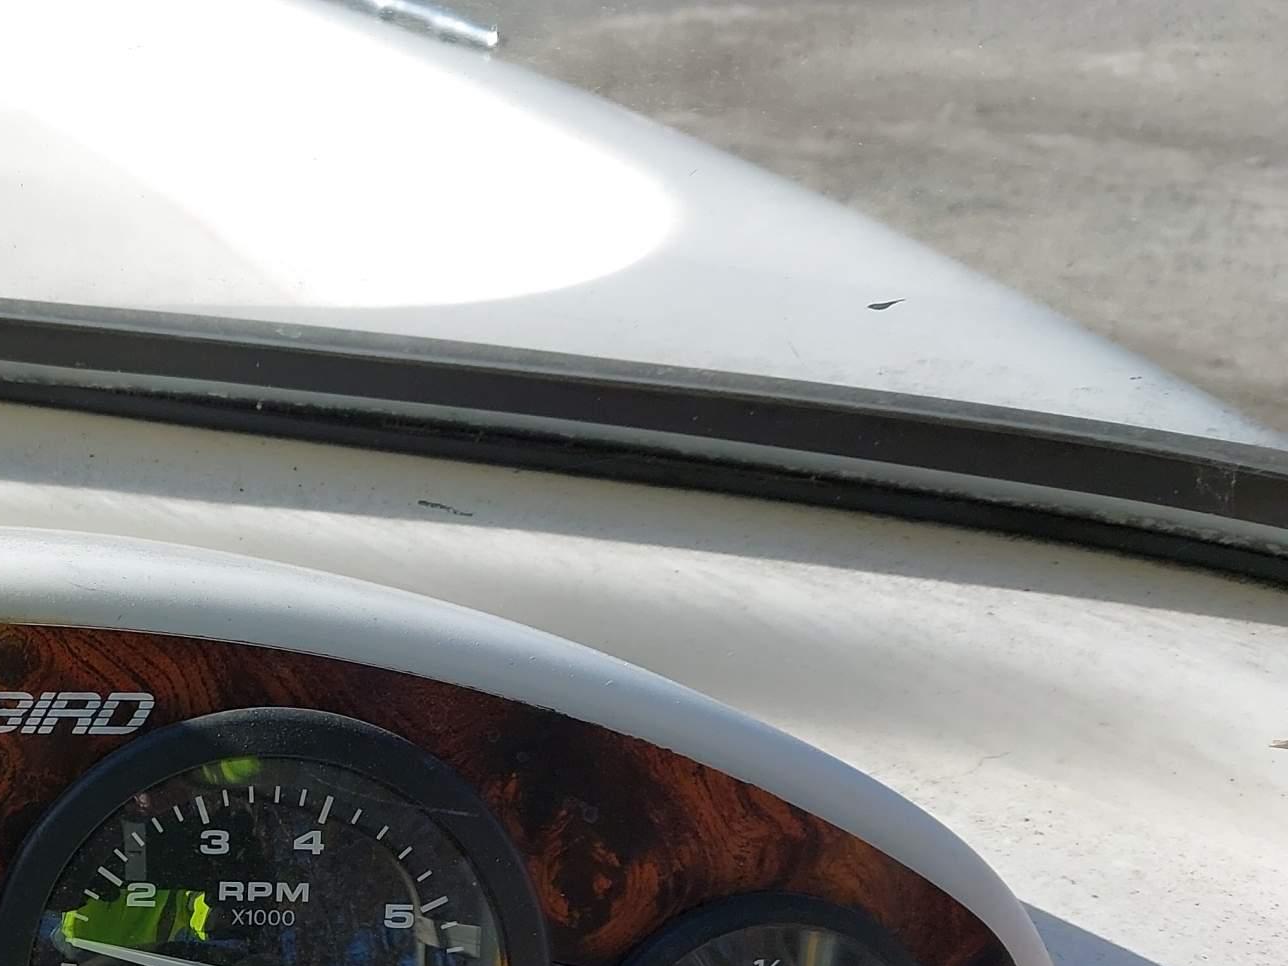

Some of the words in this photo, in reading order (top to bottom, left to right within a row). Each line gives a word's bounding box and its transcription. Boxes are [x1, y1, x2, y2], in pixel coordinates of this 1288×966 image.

[199, 830, 230, 855] 3
[293, 830, 325, 855] 4
[126, 882, 156, 907] 2
[218, 881, 310, 903] RPM
[231, 909, 296, 927] X1000
[384, 904, 415, 929] 5
